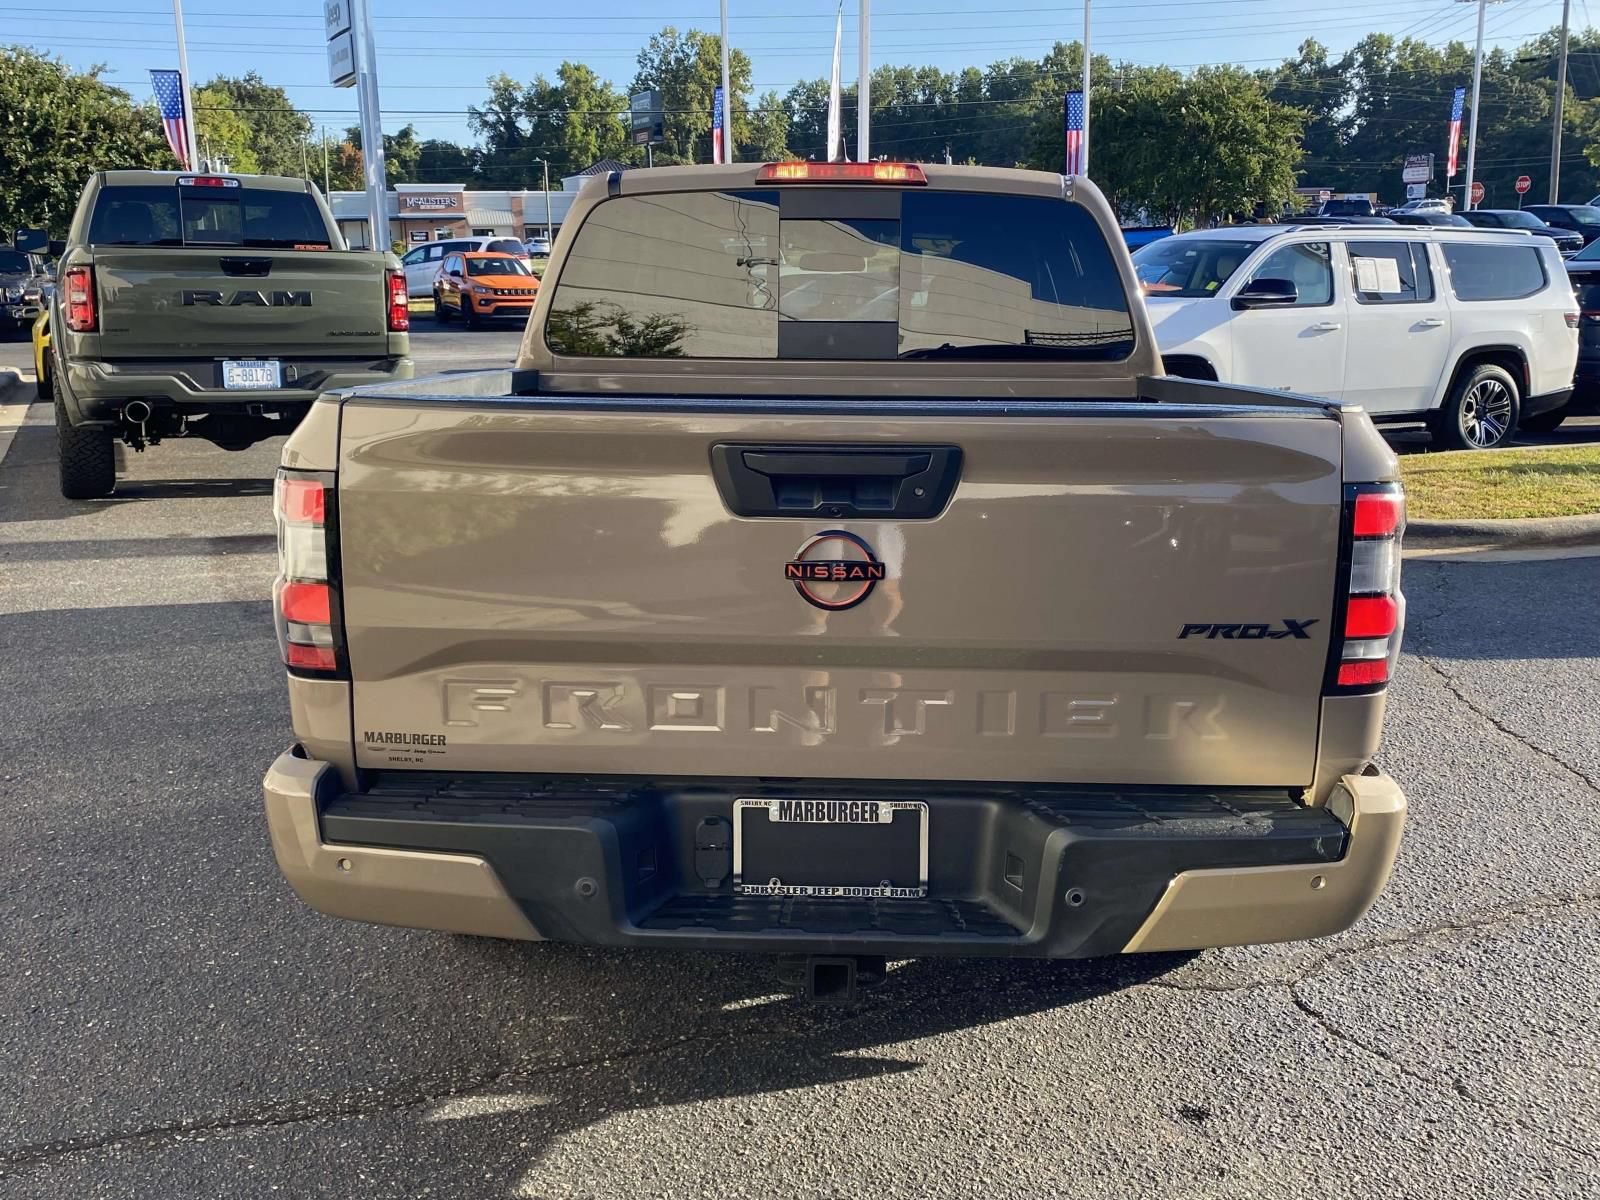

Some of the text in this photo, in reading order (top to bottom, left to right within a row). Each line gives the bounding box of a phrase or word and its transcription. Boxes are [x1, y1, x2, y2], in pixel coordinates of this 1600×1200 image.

[1472, 189, 1483, 197] TOP
[182, 289, 313, 306] RAM
[787, 565, 882, 578] NISSAN
[1177, 619, 1320, 639] PRO-X
[441, 678, 1228, 742] FRONTIER
[364, 731, 446, 746] MARBURGER
[779, 801, 879, 822] MARBURGER
[742, 885, 920, 898] CHRYSLER JEEP DODGE RAM
